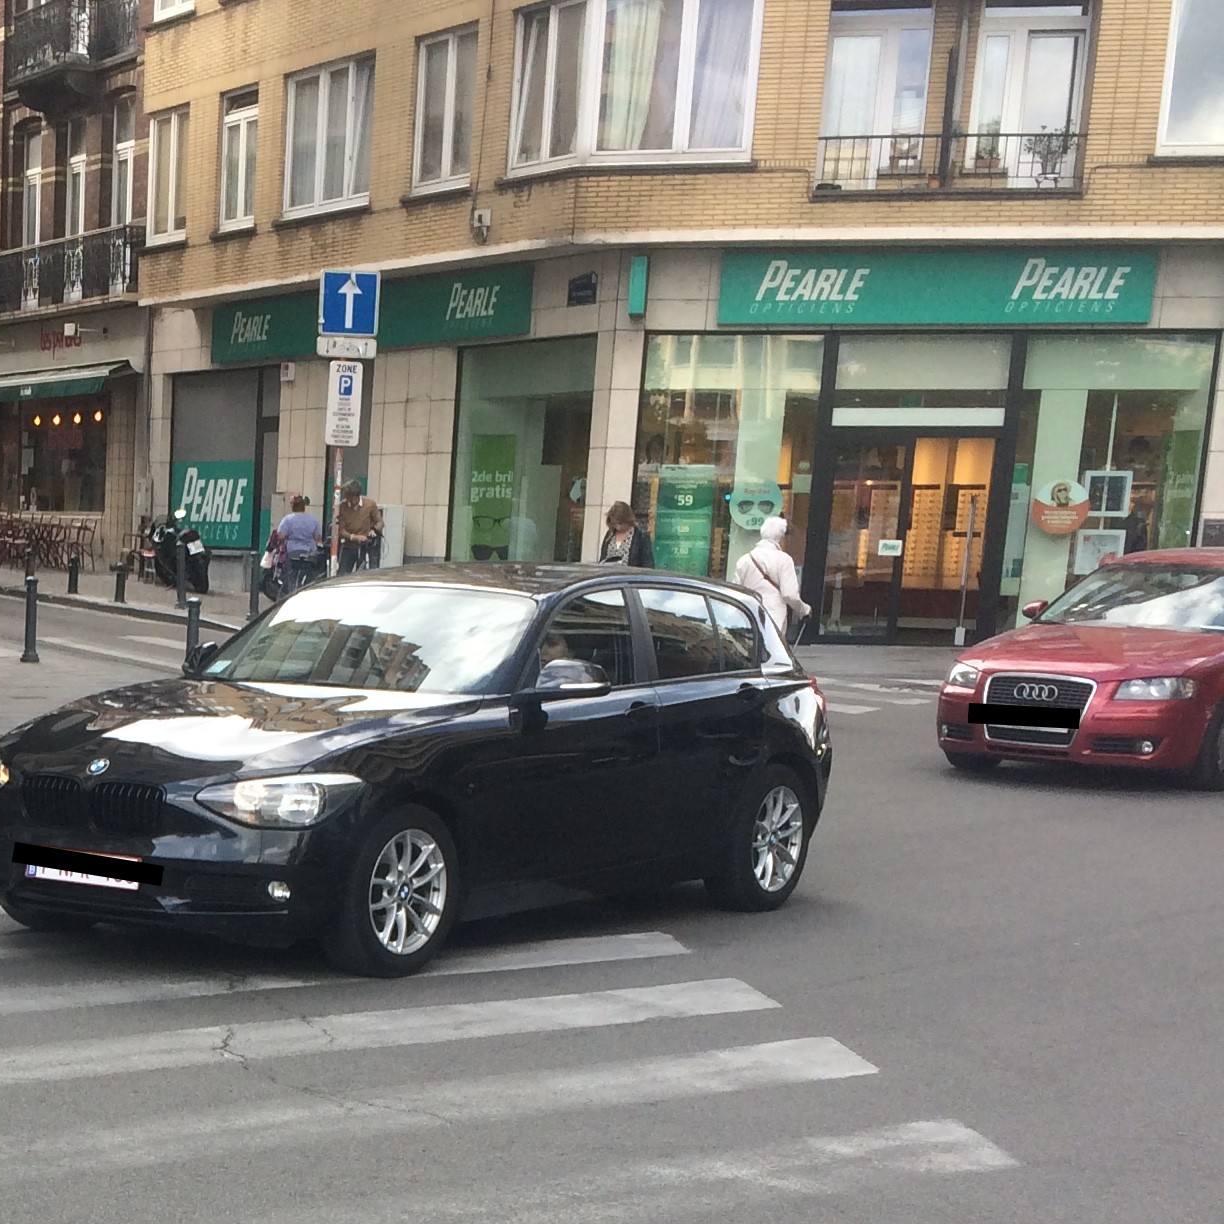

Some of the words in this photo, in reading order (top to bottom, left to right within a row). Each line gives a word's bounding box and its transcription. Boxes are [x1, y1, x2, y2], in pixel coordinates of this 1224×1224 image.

[755, 260, 870, 301] PEARLE
[1011, 258, 1132, 300] PEARLE
[446, 282, 501, 320] PEARLE
[749, 302, 856, 314] OPTICIENS
[1004, 301, 1116, 313] OPTICIENS
[230, 311, 272, 344] PEARLE
[336, 364, 358, 373] ZONE
[472, 470, 493, 483] 2de
[180, 467, 248, 523] PEARLE
[470, 483, 513, 503] gratis
